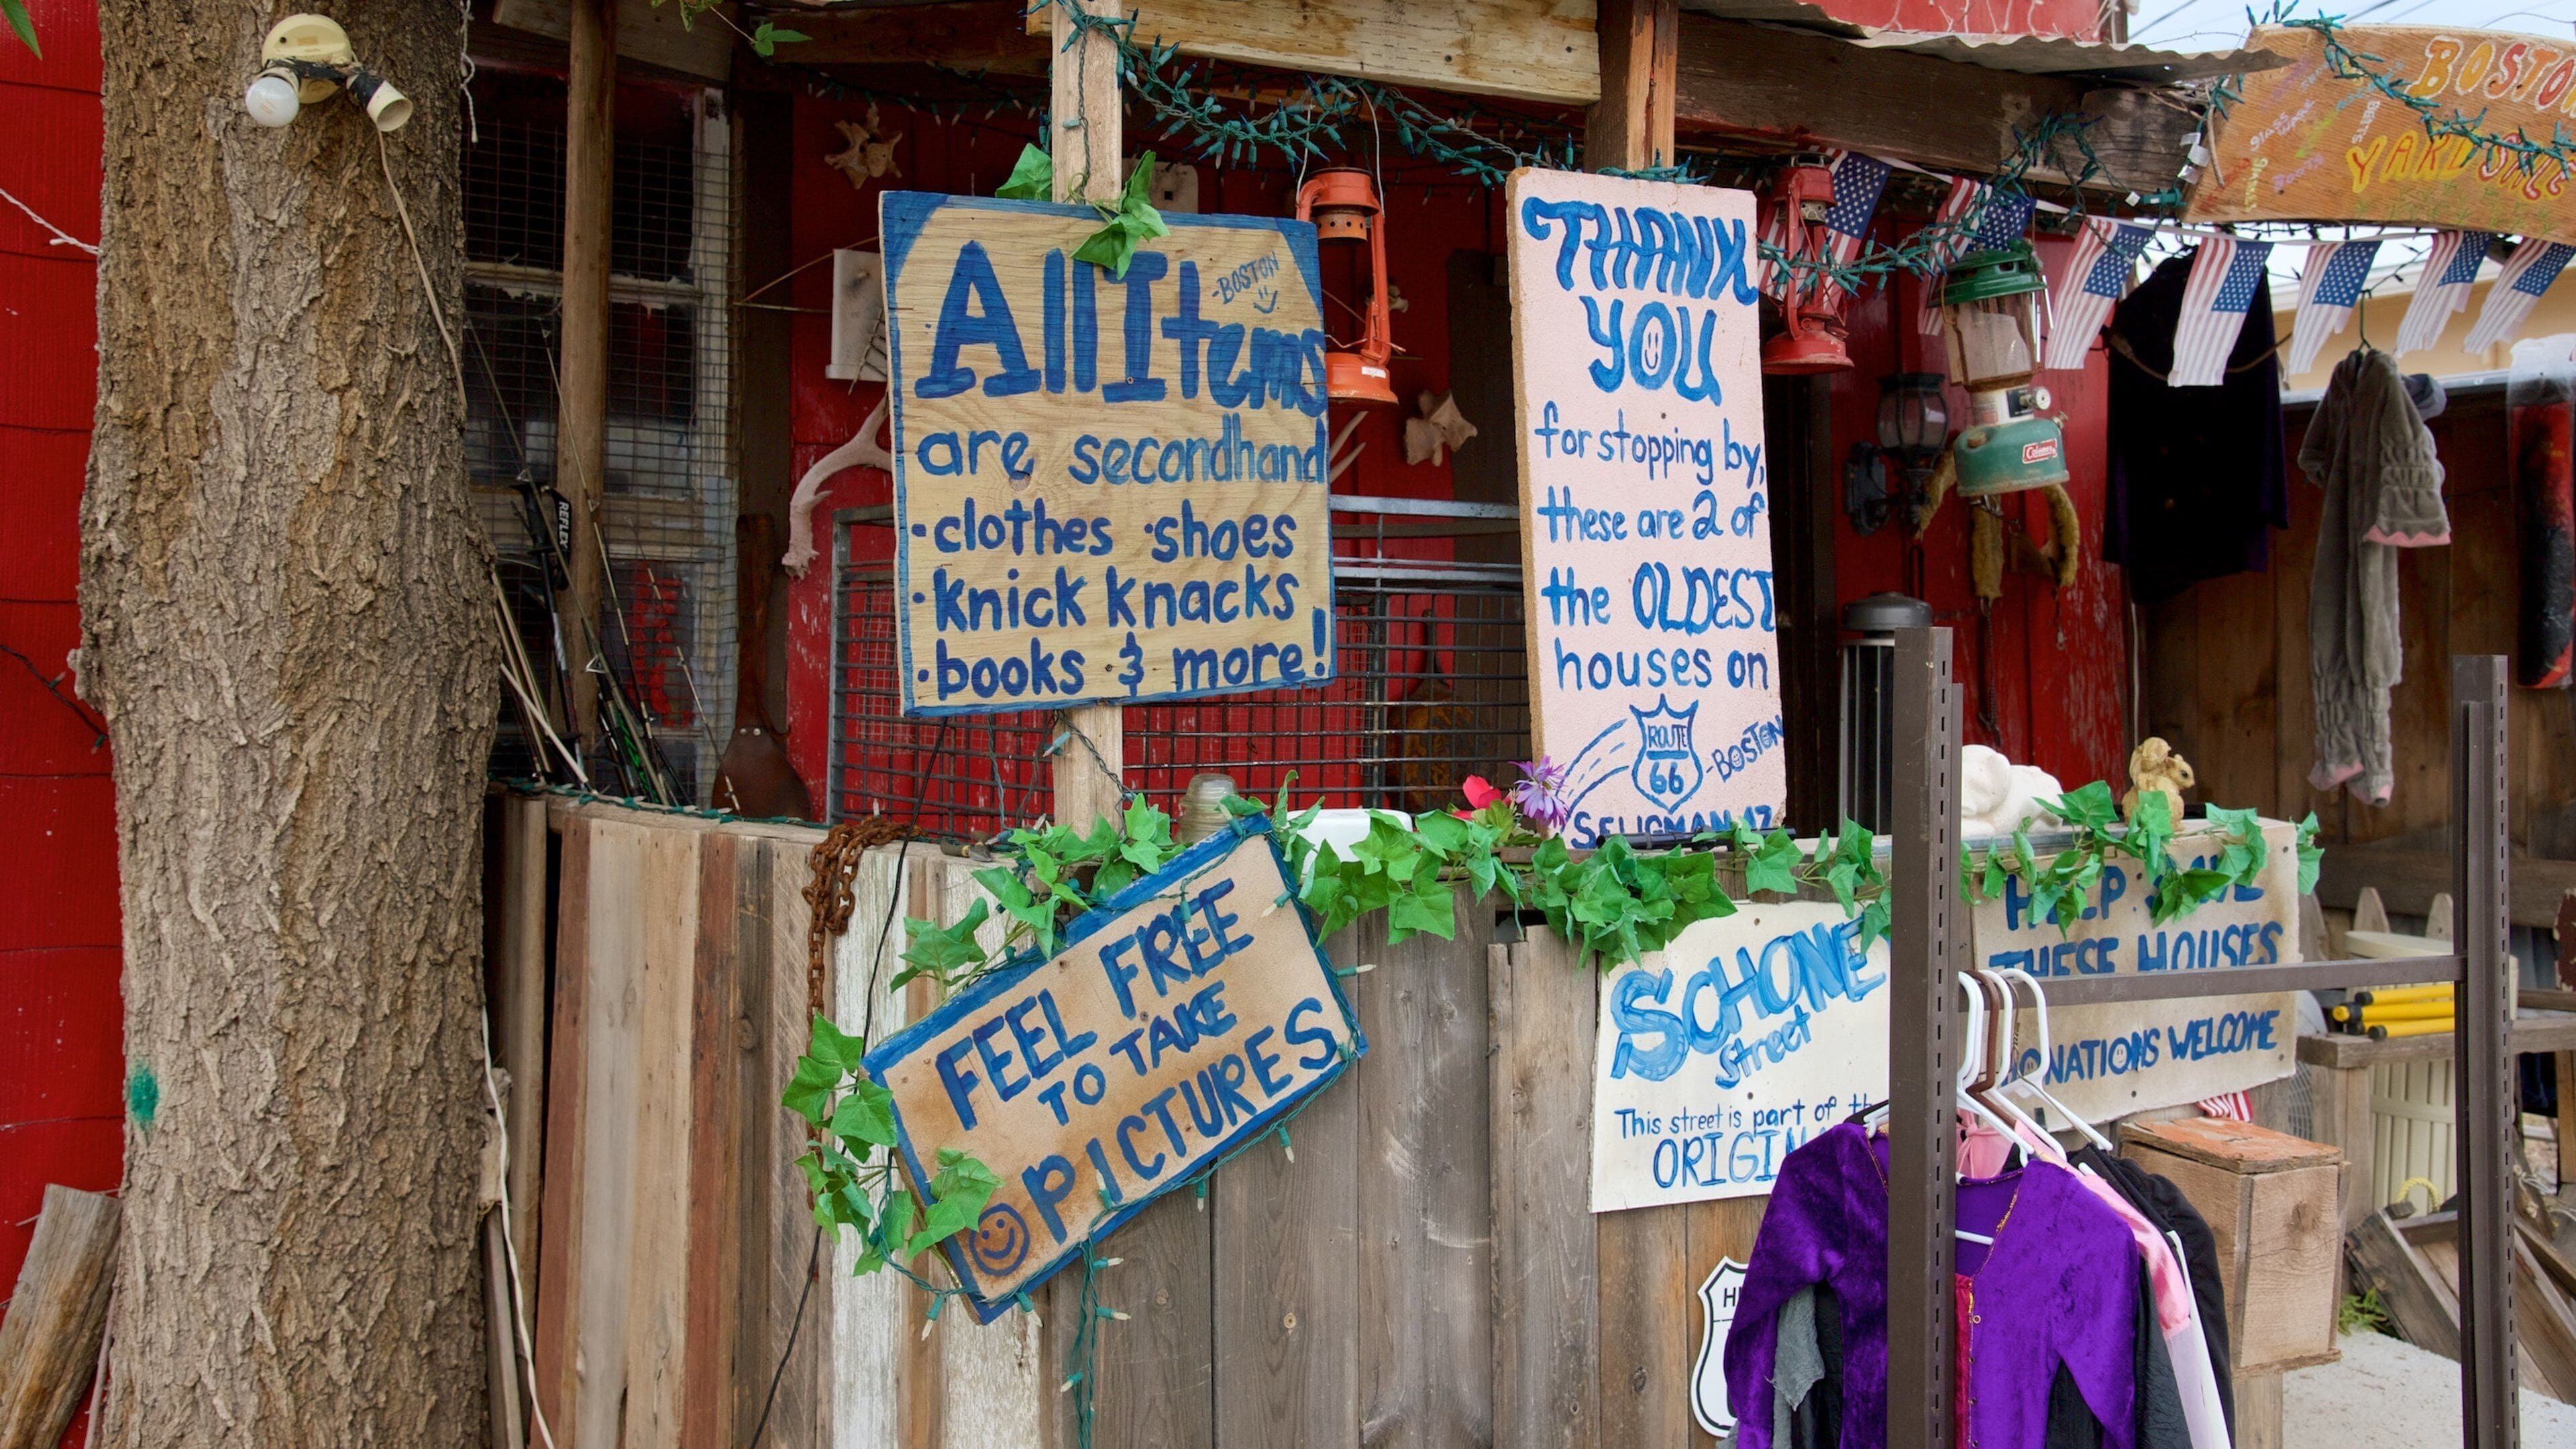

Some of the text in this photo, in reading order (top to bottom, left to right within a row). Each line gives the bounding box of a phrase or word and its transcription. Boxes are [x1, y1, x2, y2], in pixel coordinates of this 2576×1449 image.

[2404, 35, 2576, 119] BOSTO
[1578, 294, 1723, 407] YOU
[917, 413, 1326, 485] are secondhand
[1534, 400, 1765, 489] for stopping by,
[558, 500, 570, 549] REFLEX
[1537, 485, 1766, 544] these are 2 of
[933, 564, 1300, 632] knick knacks
[1541, 561, 1775, 637] the OLDEST
[936, 637, 1085, 702] books
[1172, 607, 1326, 692] more!
[1554, 637, 1769, 691] houses on
[1648, 723, 1688, 751] ROUTE
[1650, 761, 1684, 795] 66
[935, 877, 1254, 1132] FEEL FREE
[1611, 913, 1892, 1082] SCHONE
[1037, 980, 1238, 1126] TO TAKE
[2167, 1010, 2281, 1061] WELCOME
[1021, 996, 1338, 1246] PICTURES
[1614, 1093, 1873, 1139] This street is part of th
[1652, 1126, 1826, 1189] ORIGIN
